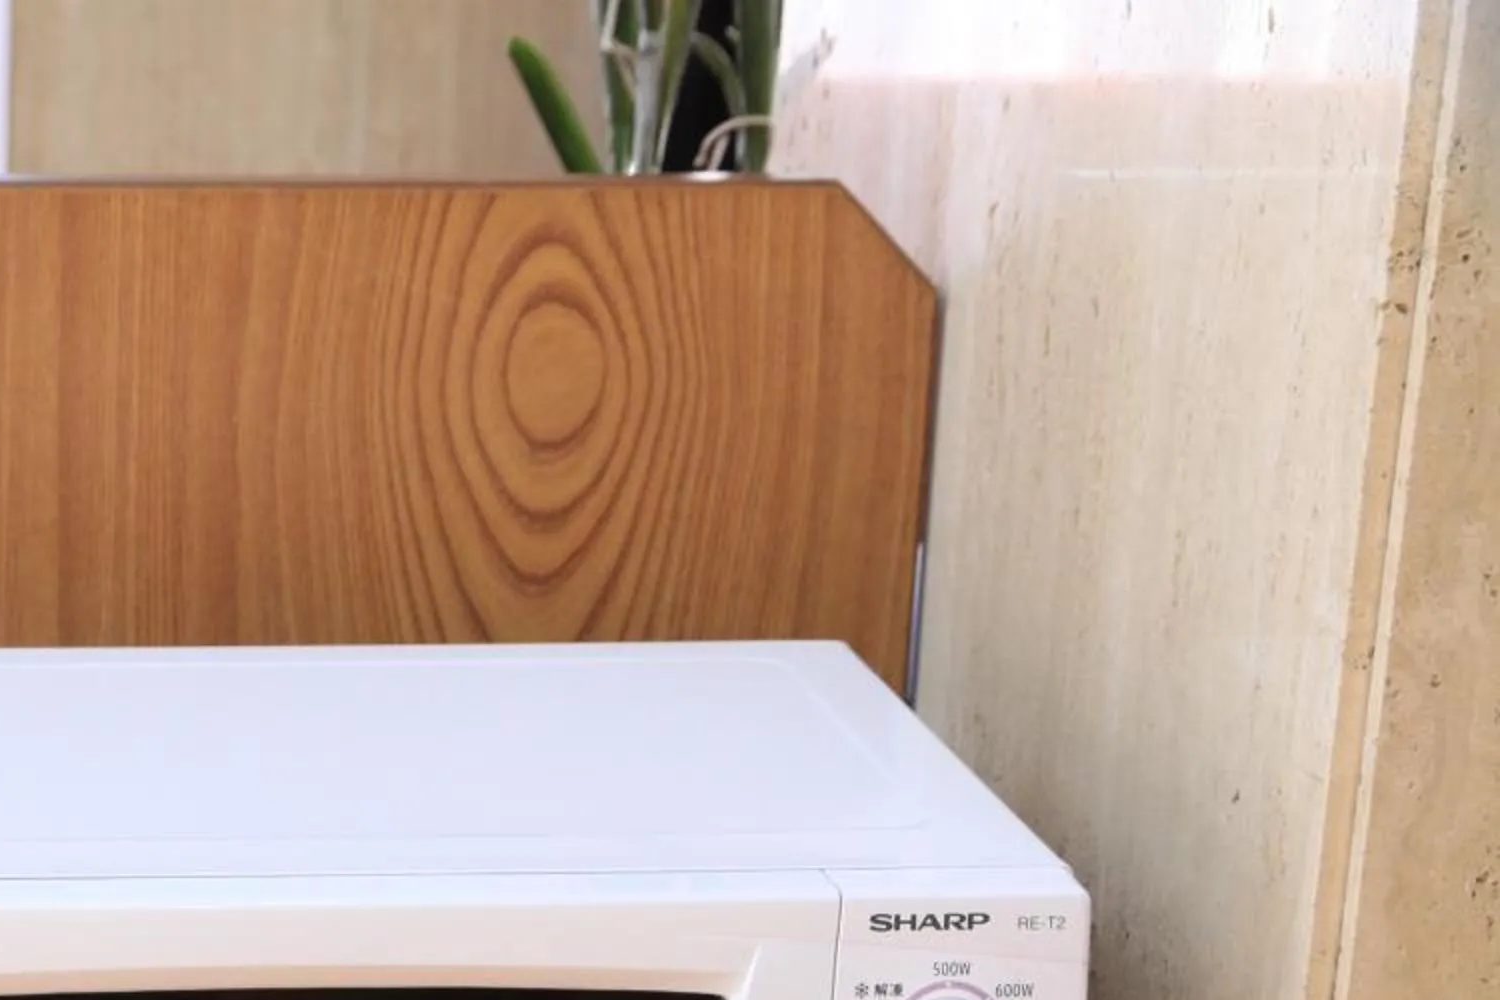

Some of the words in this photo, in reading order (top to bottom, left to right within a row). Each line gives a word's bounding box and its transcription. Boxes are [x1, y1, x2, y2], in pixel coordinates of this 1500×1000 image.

[869, 912, 990, 932] SHARP
[1017, 915, 1067, 931] RE-T2
[932, 962, 971, 976] 500W
[873, 983, 904, 998] 解凍
[995, 983, 1034, 998] 600W
